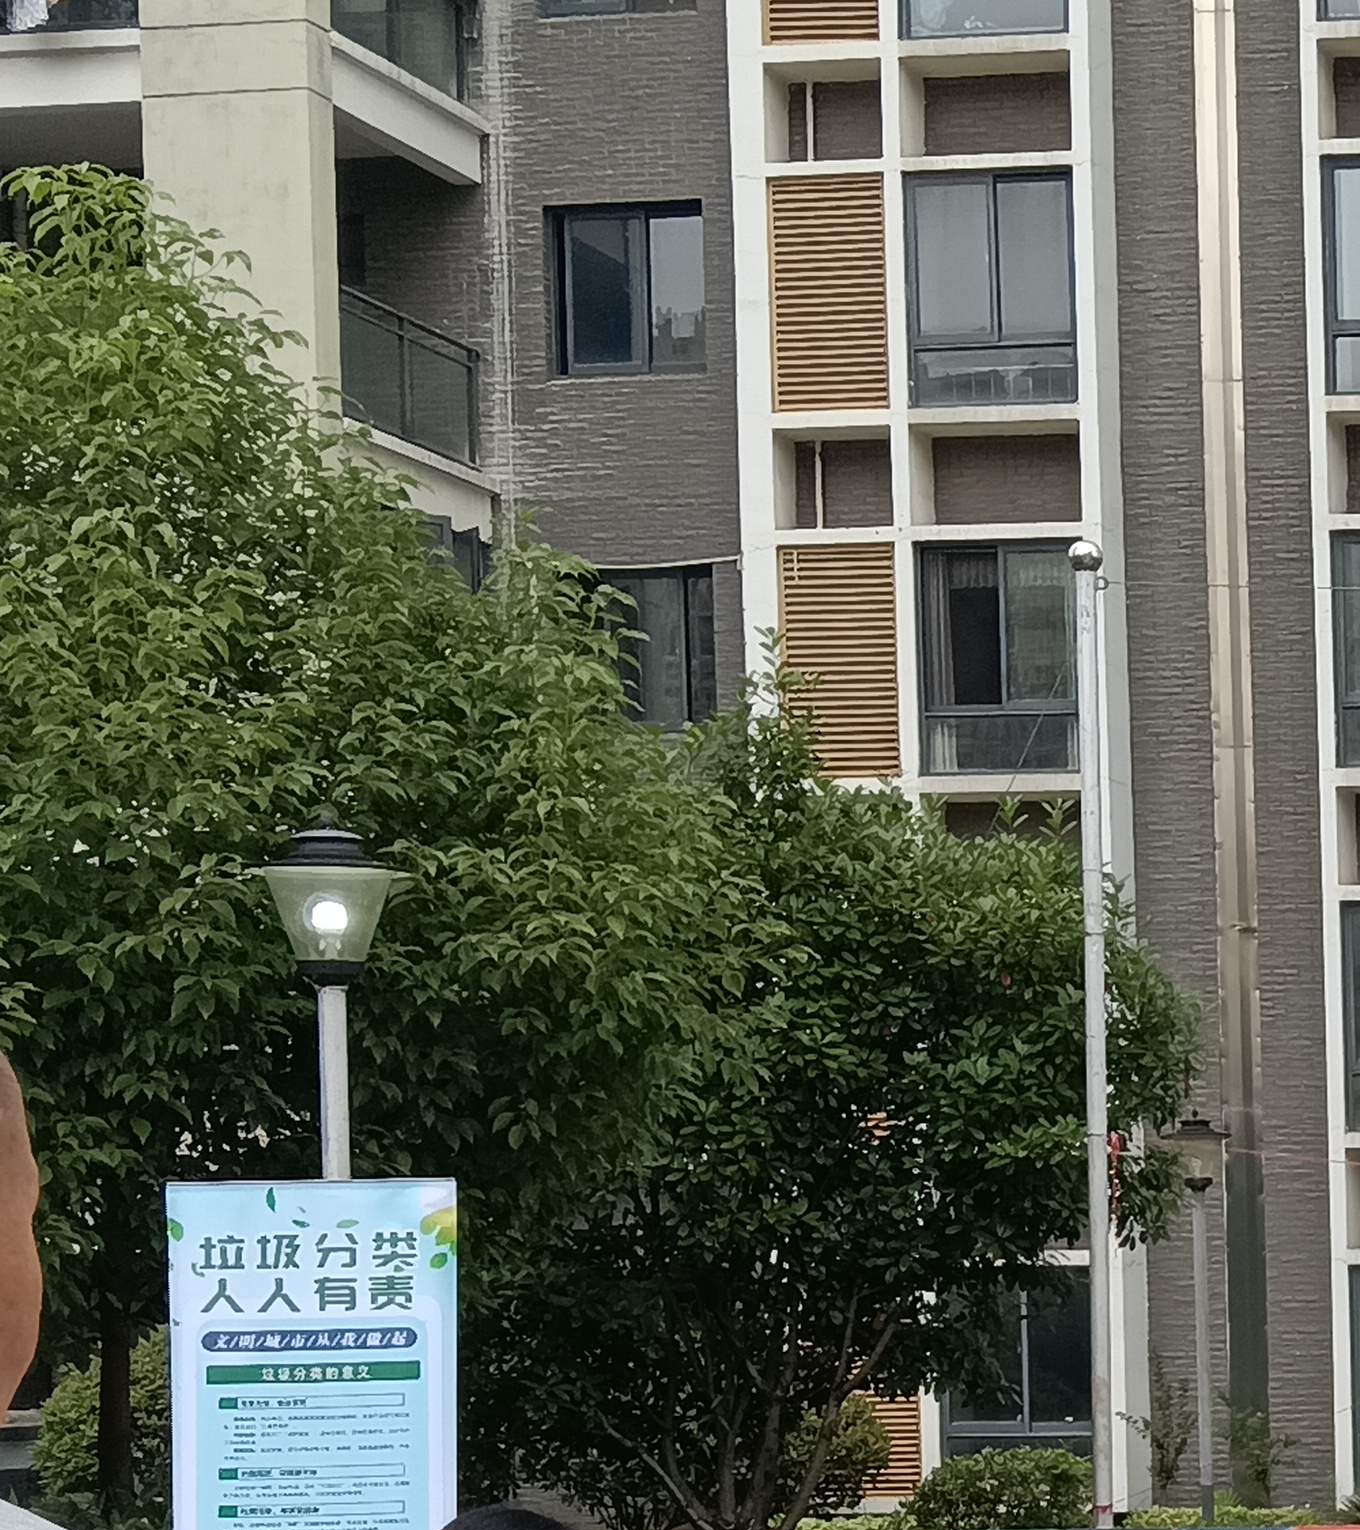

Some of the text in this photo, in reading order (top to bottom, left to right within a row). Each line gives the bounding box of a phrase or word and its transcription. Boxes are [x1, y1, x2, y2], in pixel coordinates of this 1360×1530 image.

[199, 1231, 418, 1270] 垃圾分类
[200, 1275, 414, 1314] 人人有责
